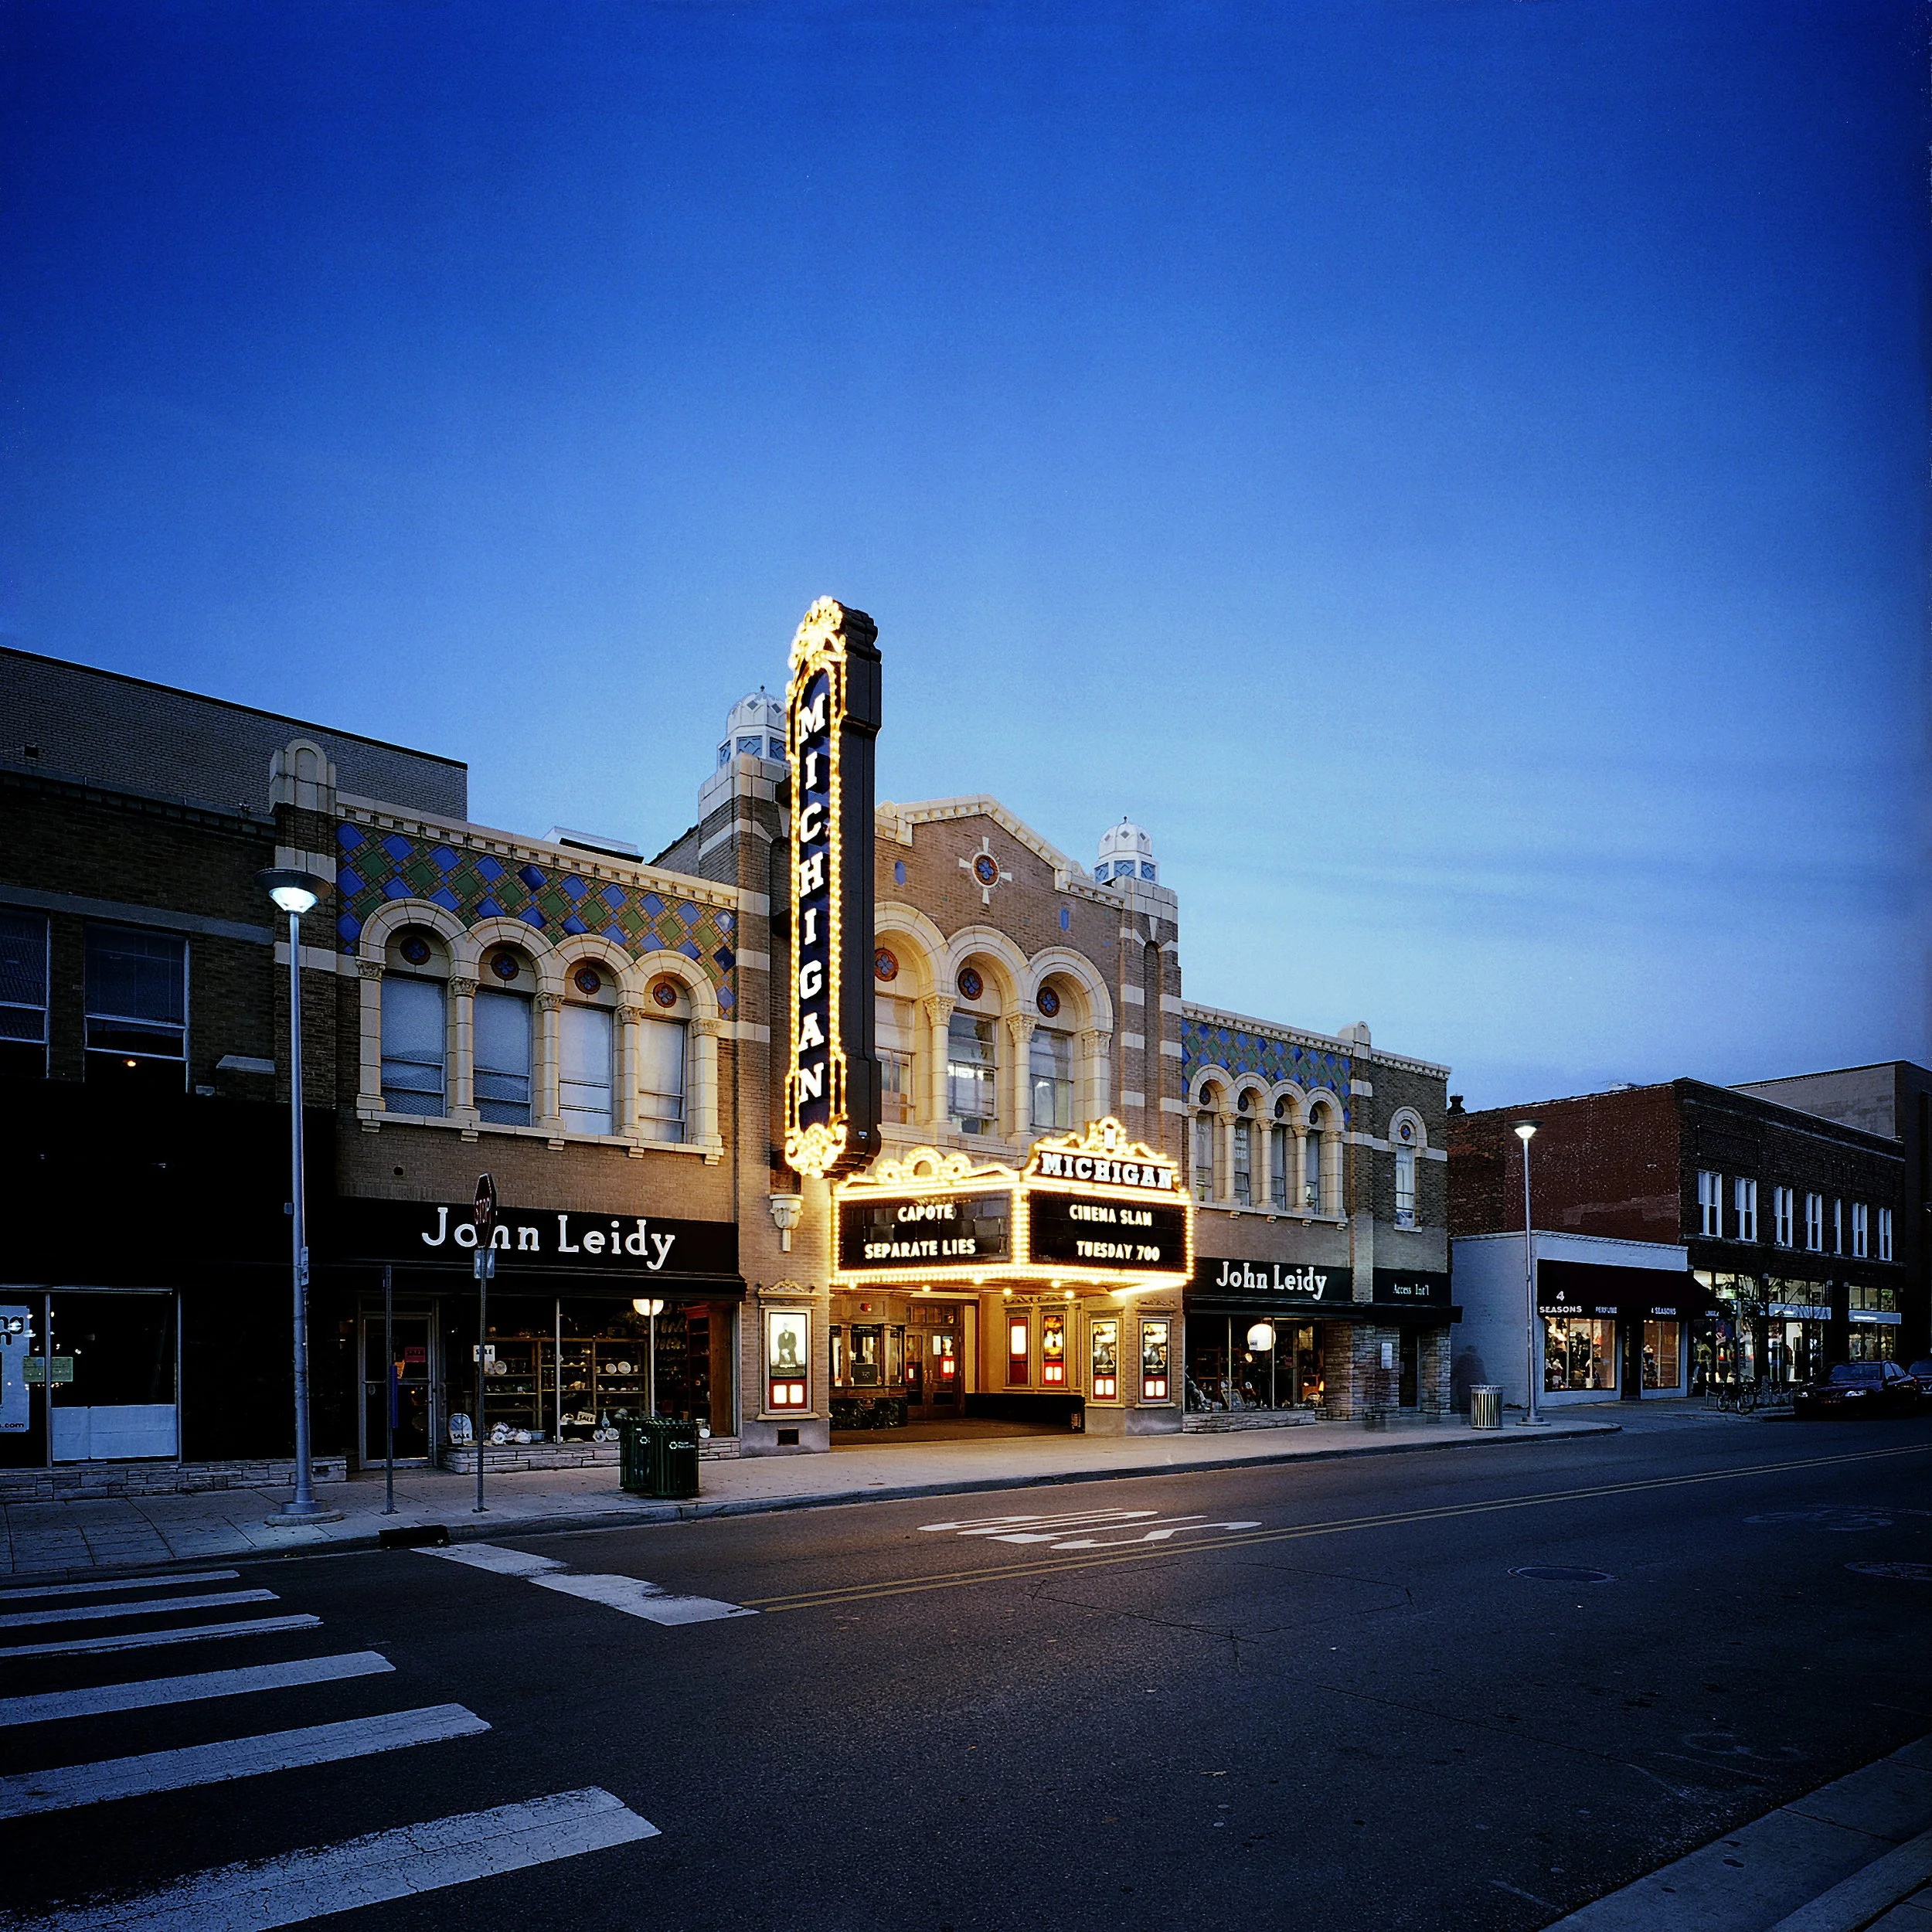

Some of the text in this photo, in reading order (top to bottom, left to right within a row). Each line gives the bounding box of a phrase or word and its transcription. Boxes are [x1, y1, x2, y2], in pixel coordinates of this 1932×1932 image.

[798, 692, 825, 1104] MICHIGAN
[1042, 1152, 1172, 1189] MICHIGAN
[474, 1197, 492, 1225] STOP
[897, 1203, 954, 1222] CAPOTE
[1069, 1204, 1152, 1226] CINEMA SLAM
[558, 1215, 675, 1270] Leidy
[864, 1238, 976, 1260] SEPARATE LIES
[1077, 1240, 1160, 1261] TUESDAY 700
[1216, 1261, 1327, 1300] John Leidy
[1556, 1291, 1565, 1301] 4
[579, 1413, 594, 1423] SALE
